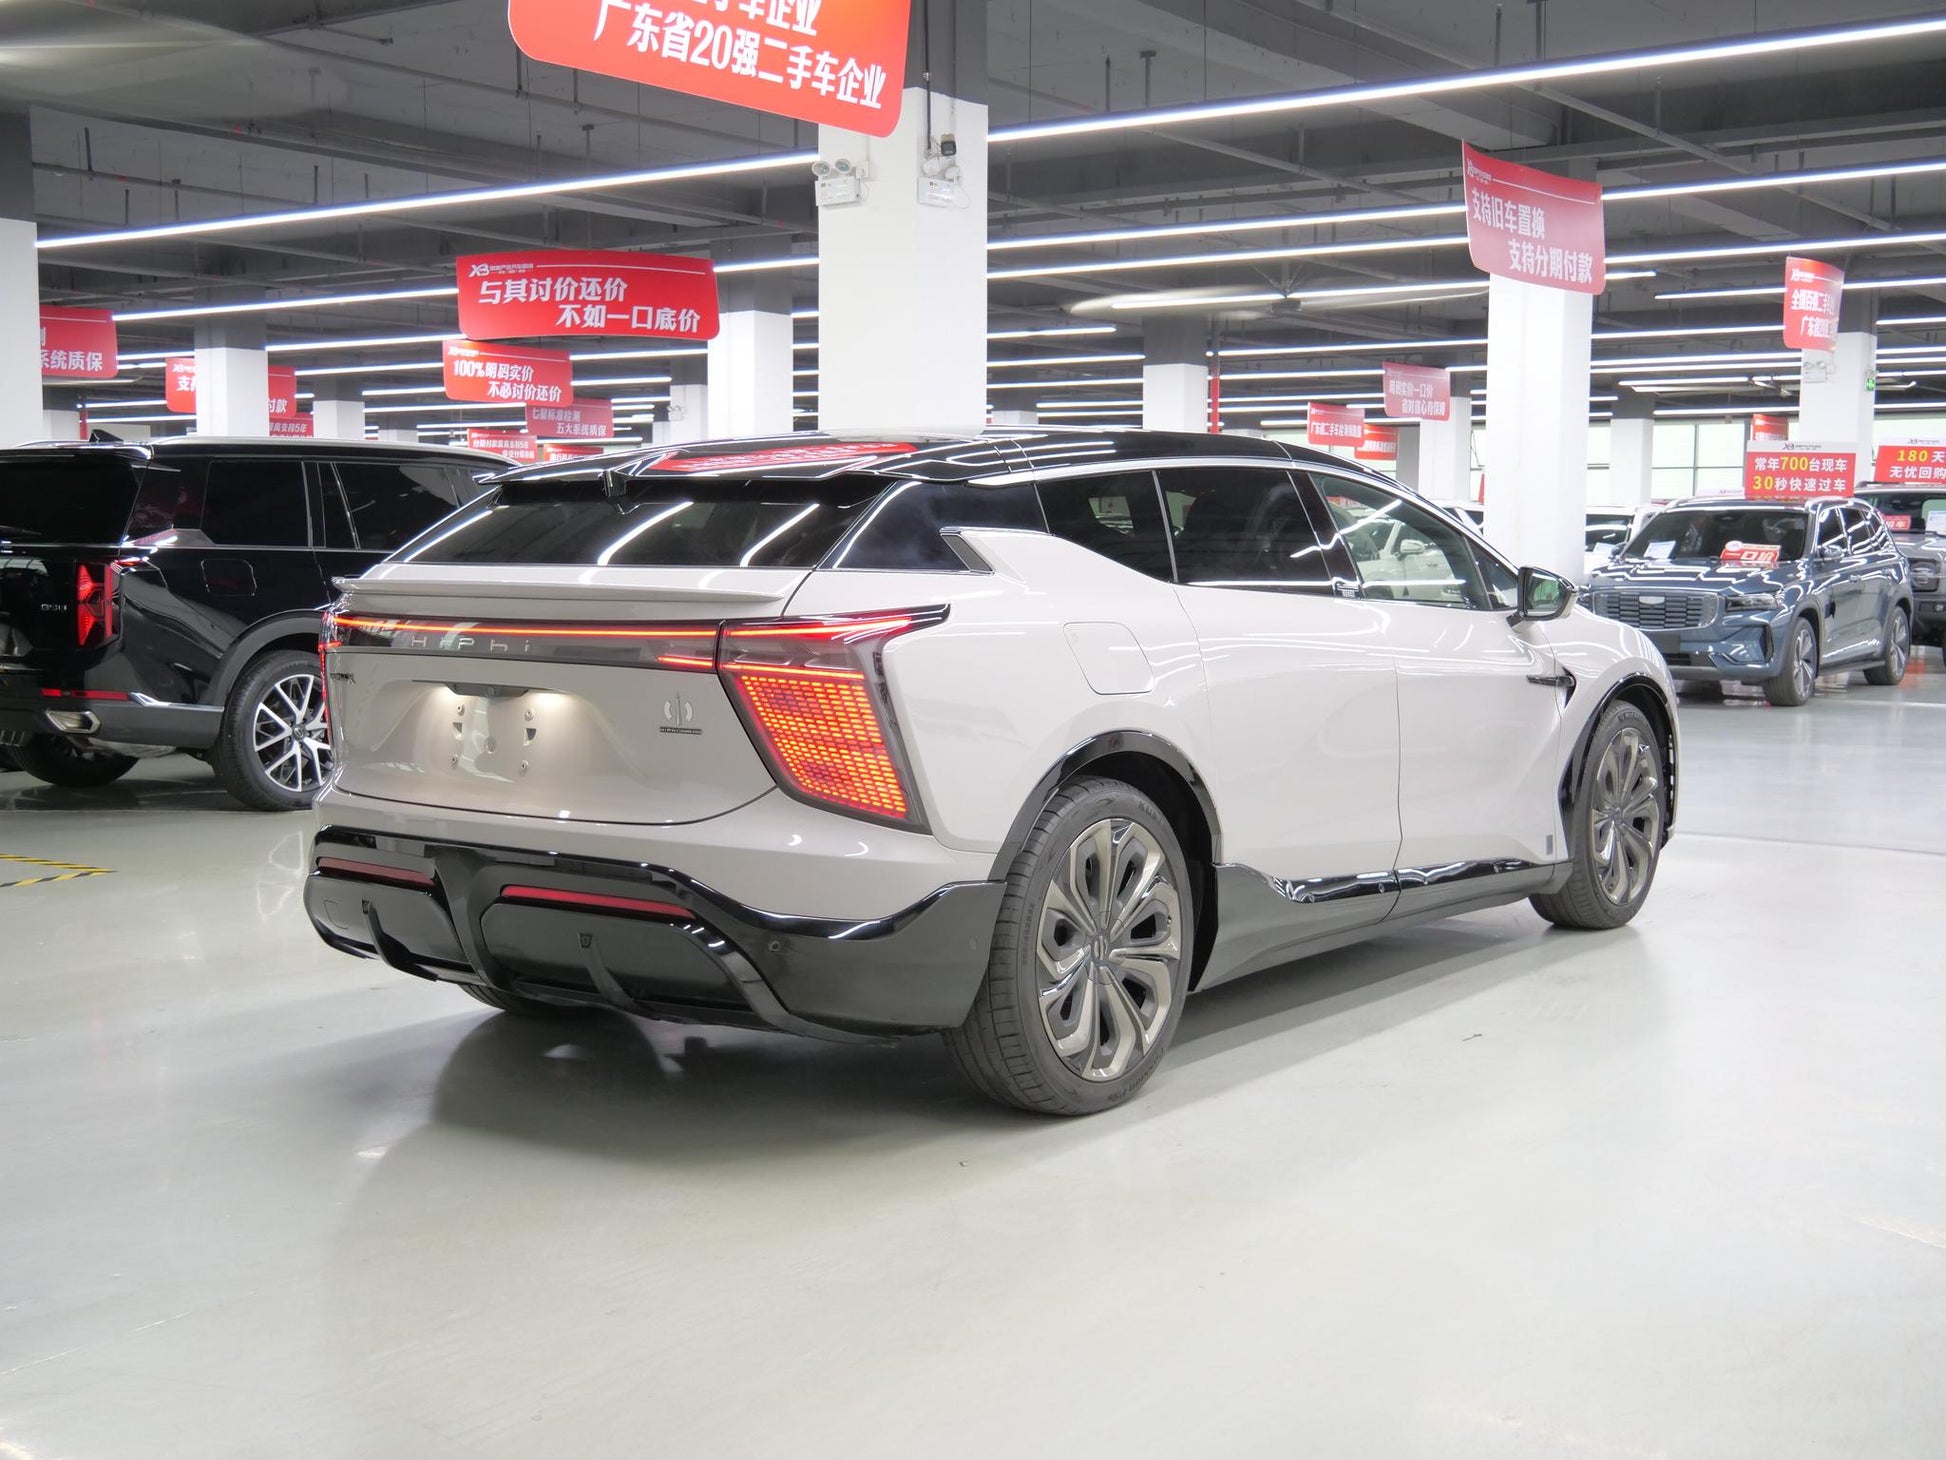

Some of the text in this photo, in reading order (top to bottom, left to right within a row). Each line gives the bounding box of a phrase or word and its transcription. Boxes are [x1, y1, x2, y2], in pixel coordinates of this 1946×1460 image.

[593, 0, 886, 109] 广东省20强二手车企业
[1472, 187, 1545, 239] 支持旧车置换
[1508, 238, 1593, 283] 支持分期付款
[479, 277, 627, 304] 与其讨价还价
[556, 304, 700, 332] 不如一口底价
[453, 359, 534, 382] 100%明码实价
[487, 381, 561, 402] 不必讨价还价
[1754, 456, 1848, 473] 常年700台现车
[1896, 449, 1944, 463] 180天
[1752, 475, 1847, 492] 30秒快速过车
[1888, 465, 1946, 480] 无忧回购
[1724, 551, 1776, 561] 一口价
